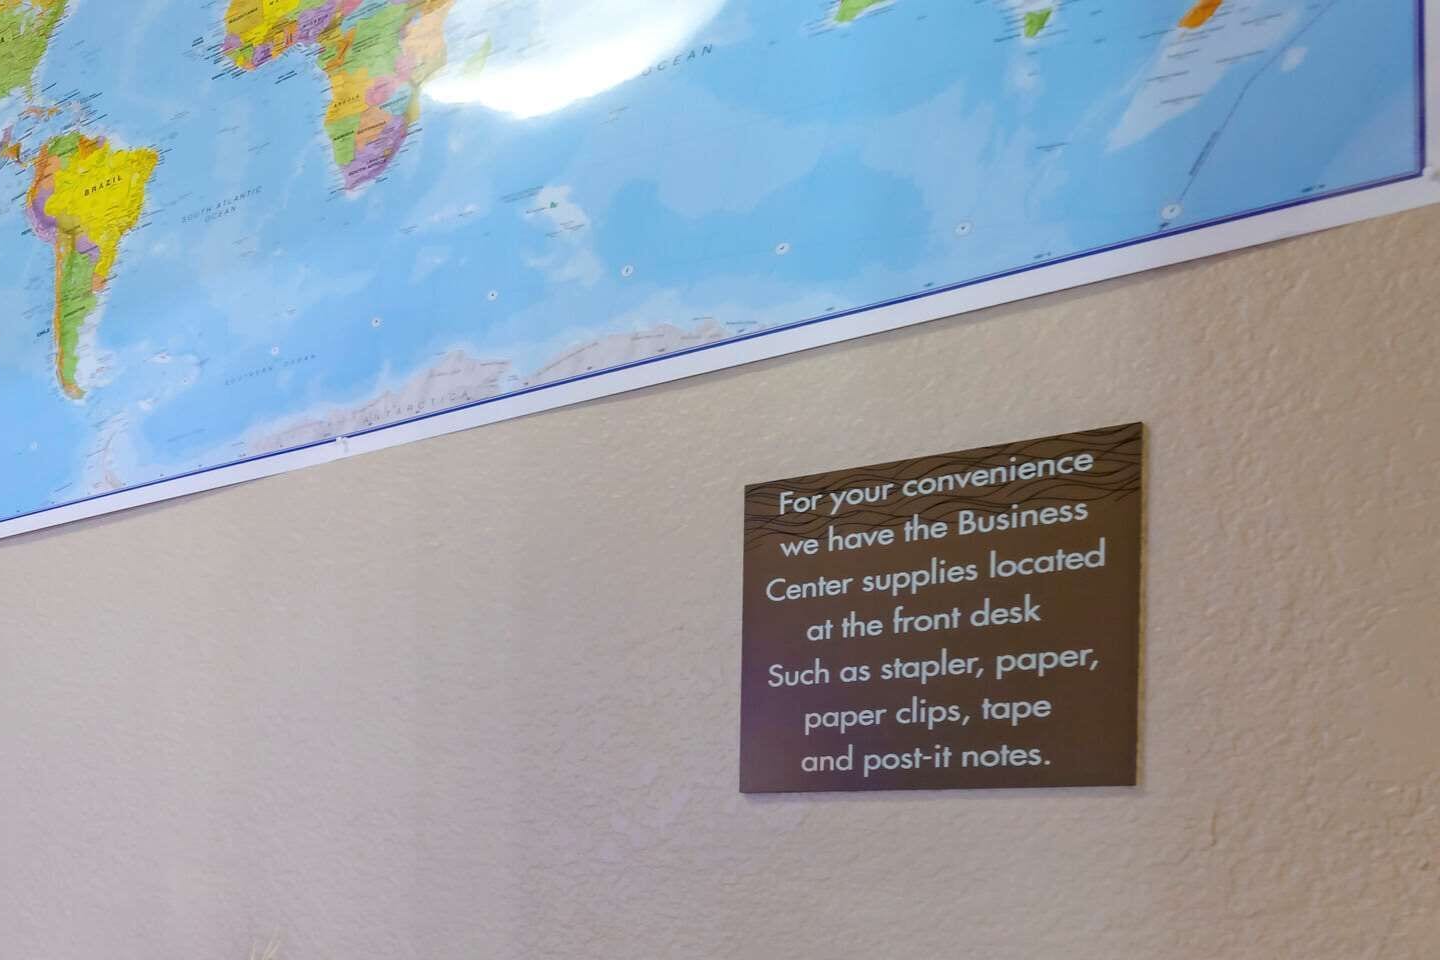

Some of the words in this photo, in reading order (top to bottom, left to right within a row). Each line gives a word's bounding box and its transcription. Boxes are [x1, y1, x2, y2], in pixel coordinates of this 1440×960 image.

[84, 175, 123, 197] BRAZIL
[779, 491, 822, 515] For
[830, 483, 894, 514] your
[902, 453, 1094, 497] convenience
[780, 534, 819, 557] we
[829, 526, 894, 552] have
[904, 514, 948, 542] the
[959, 502, 1088, 535] Business
[766, 576, 853, 601] Center
[862, 558, 978, 596] supplies
[991, 537, 1106, 578] located
[807, 621, 833, 641] at
[842, 612, 883, 638] the
[894, 607, 961, 634] front
[970, 593, 1041, 627] desk
[768, 659, 829, 687] Such
[840, 664, 870, 684] as
[881, 648, 984, 684] stapler,
[996, 647, 1099, 680] paper,
[805, 705, 887, 735] paper
[896, 696, 970, 729] clips,
[982, 697, 1052, 726] tape
[801, 744, 853, 772] and
[864, 744, 952, 777] post-it
[962, 744, 1050, 768] notes.
